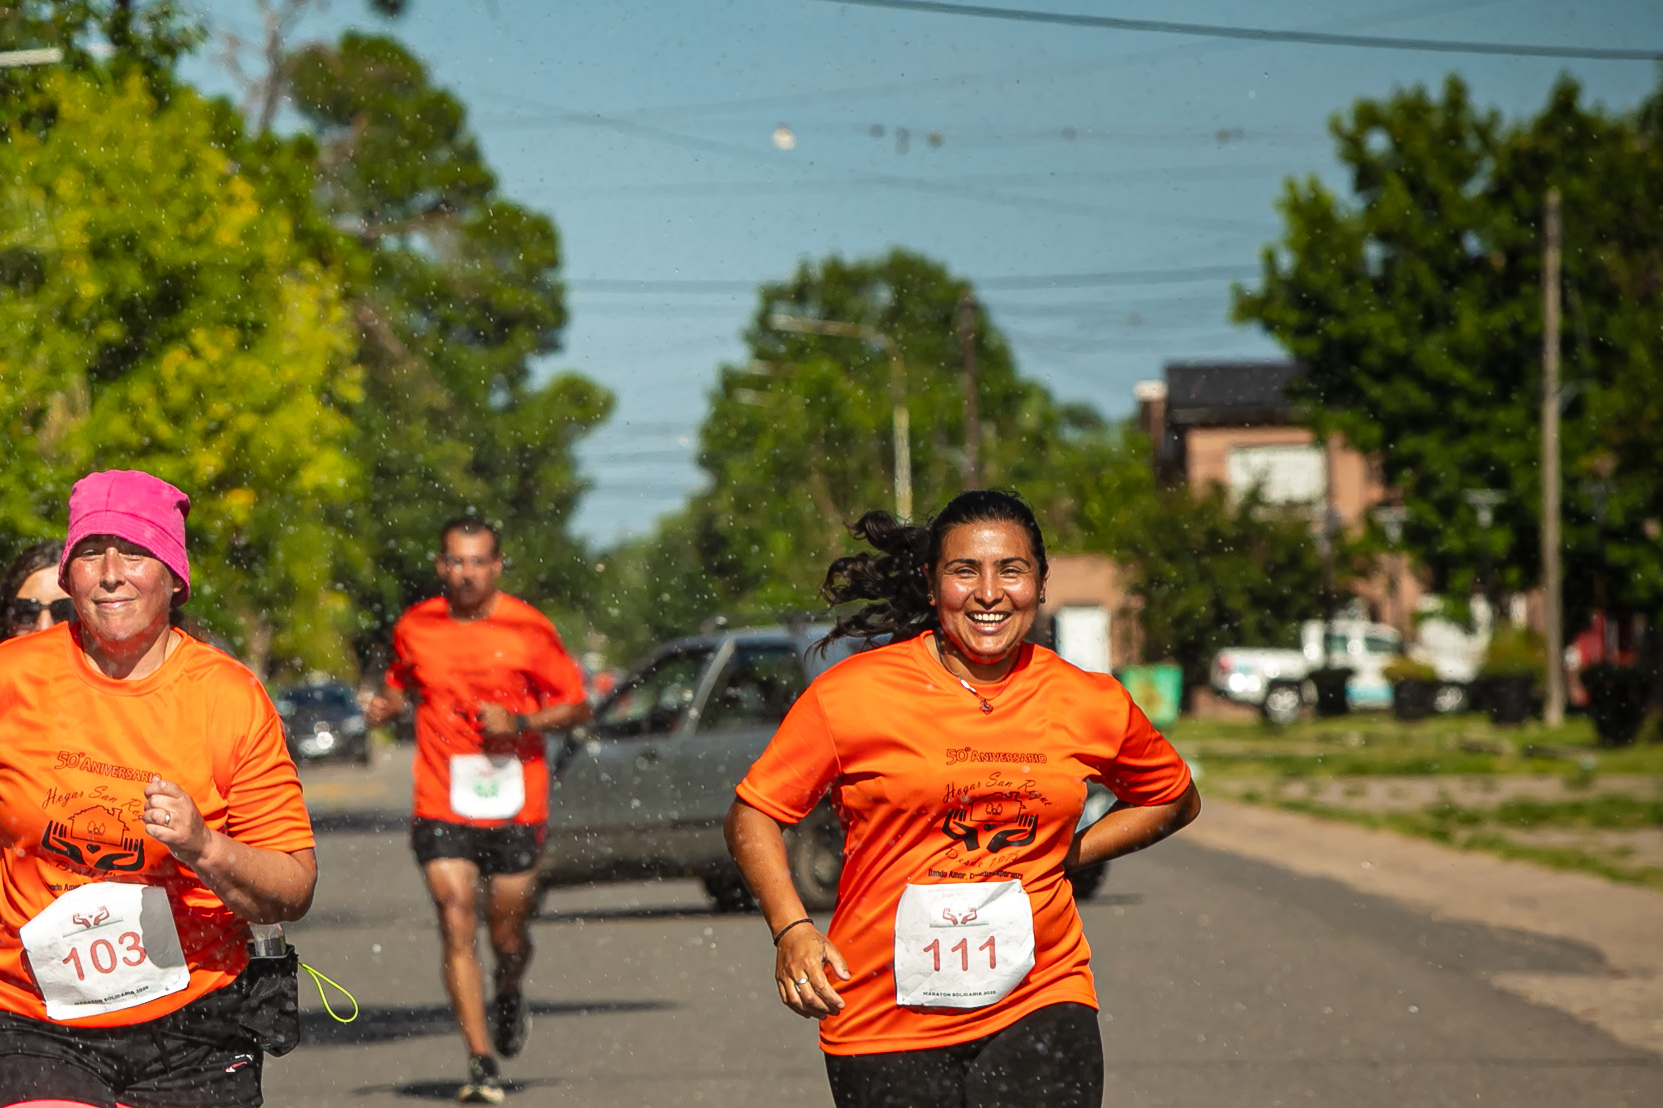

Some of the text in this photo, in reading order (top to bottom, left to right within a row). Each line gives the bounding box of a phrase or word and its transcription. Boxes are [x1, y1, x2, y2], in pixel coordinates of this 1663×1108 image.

[41, 786, 84, 810] Hogar
[87, 785, 118, 803] San
[942, 781, 981, 804] Hogar
[984, 771, 1013, 788] San
[62, 931, 147, 981] 103
[923, 935, 997, 972] 111
